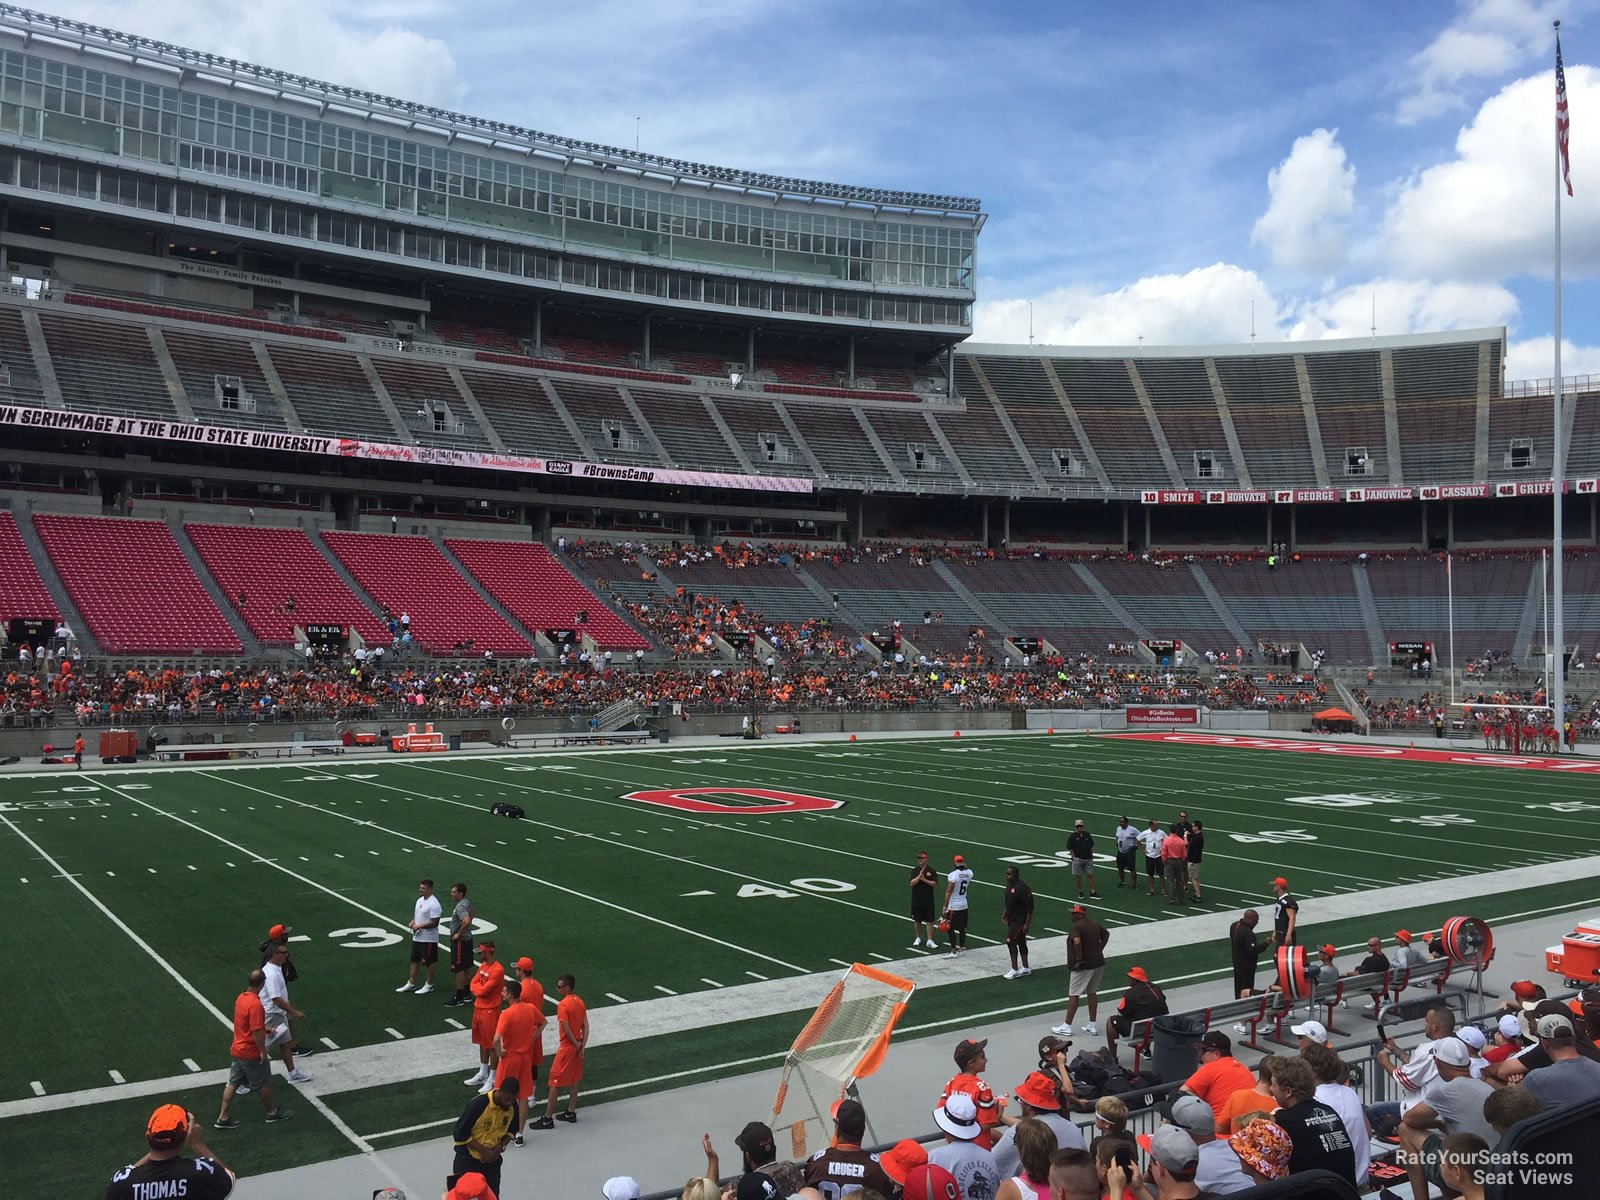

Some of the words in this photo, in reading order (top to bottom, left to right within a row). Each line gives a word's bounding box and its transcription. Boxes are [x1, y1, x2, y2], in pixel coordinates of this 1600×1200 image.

[21, 410, 114, 432] SCRIMMAGE
[117, 420, 136, 434] AT
[139, 421, 166, 437] THE
[169, 424, 204, 441] OHIO
[207, 428, 249, 446] STATE
[252, 433, 331, 453] UNIVERSITY
[583, 465, 654, 482] #BrownsCamp
[1422, 488, 1436, 499] 40
[1441, 486, 1485, 498] CASSADY
[1499, 485, 1513, 496] 45
[1579, 481, 1594, 492] 47
[1144, 491, 1156, 502] 10
[1163, 492, 1194, 502] SMITH
[1210, 492, 1222, 502] 22
[1227, 491, 1266, 502] HORVATH
[1278, 491, 1290, 502] 27
[1297, 490, 1334, 501] GEORGE
[1365, 488, 1412, 500] JANOWICZ
[1130, 715, 1194, 723] OhioStateBuckeyes.com
[736, 877, 857, 899] 40
[959, 880, 967, 896] 6
[828, 1161, 865, 1178] KRUGER
[132, 1179, 188, 1200] THOMAS
